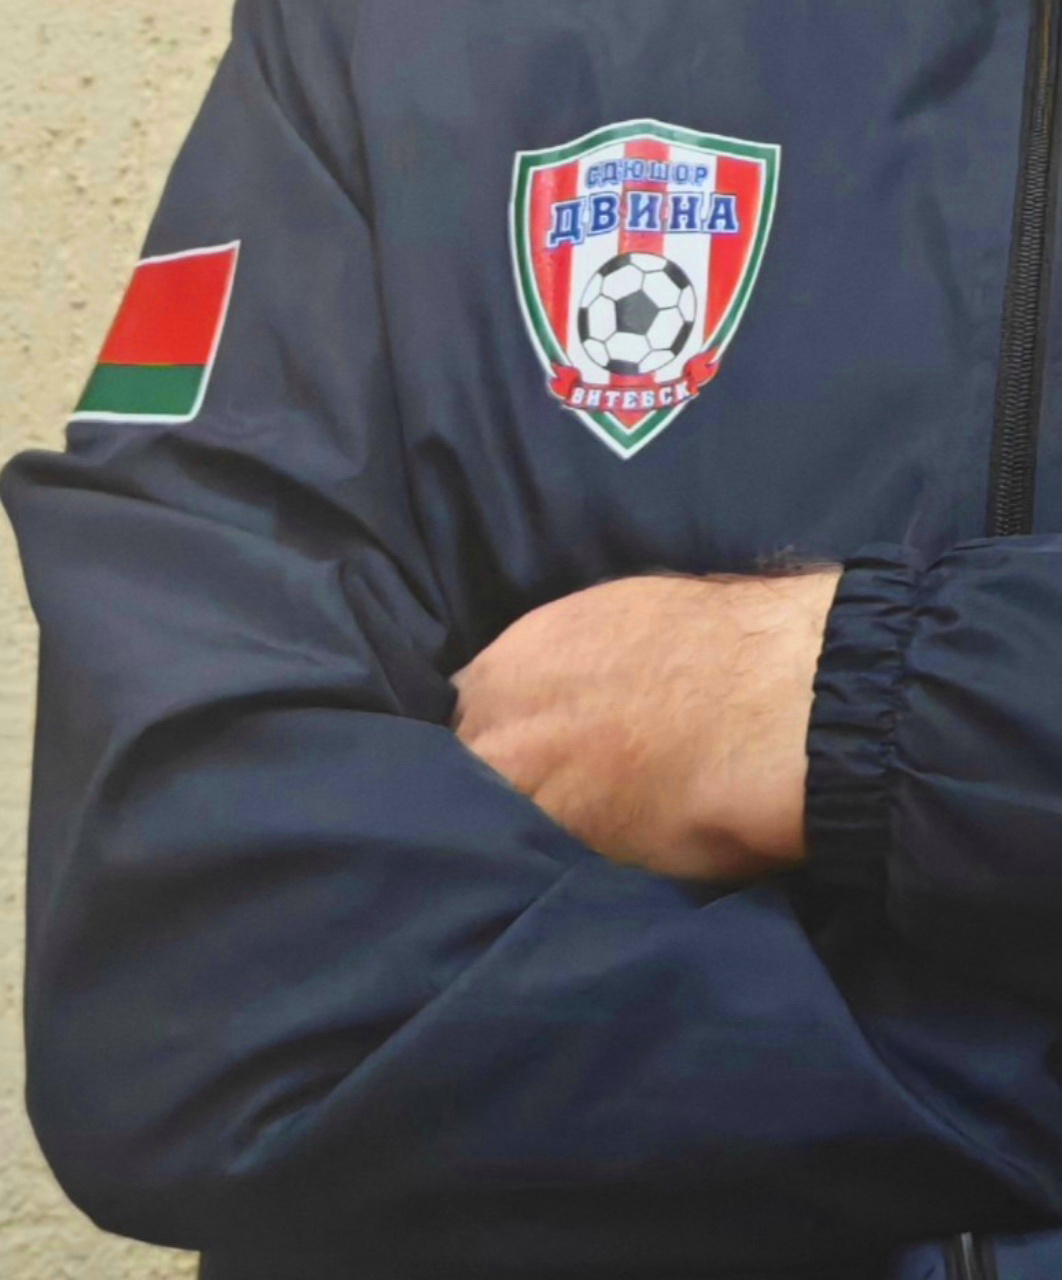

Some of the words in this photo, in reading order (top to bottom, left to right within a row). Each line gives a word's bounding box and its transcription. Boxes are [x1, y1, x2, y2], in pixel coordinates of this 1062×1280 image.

[586, 159, 709, 188] СДЮШОР
[547, 191, 740, 248] ДВИНА
[571, 380, 693, 409] ВИТЕБСК
